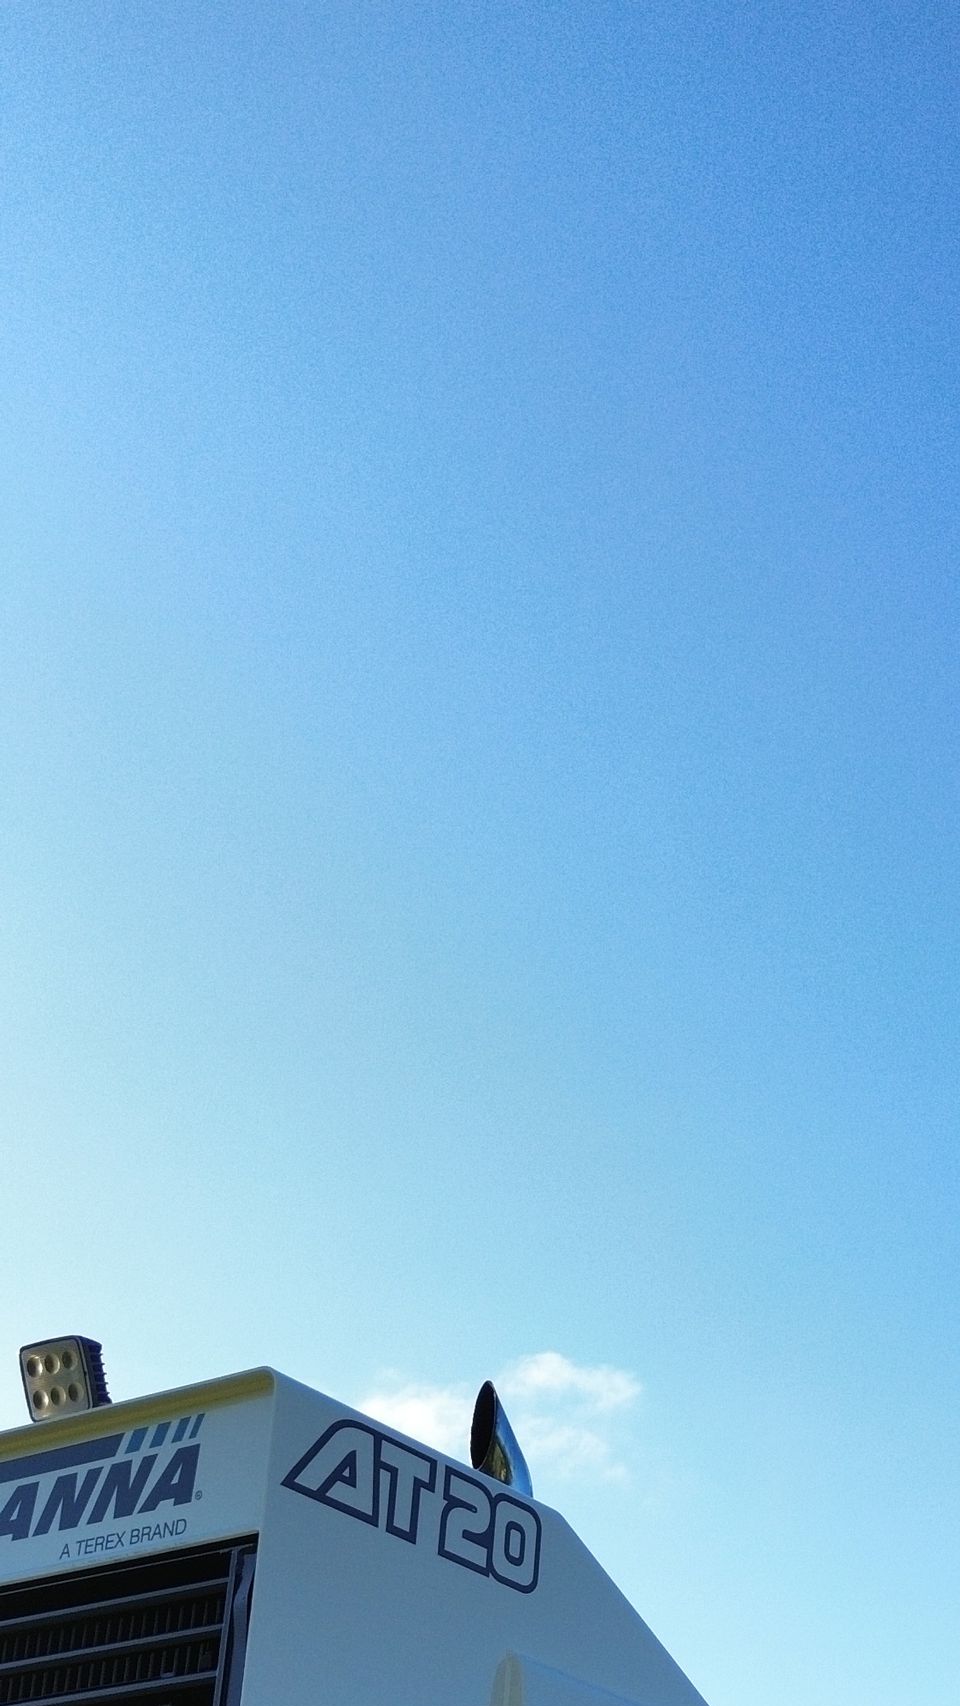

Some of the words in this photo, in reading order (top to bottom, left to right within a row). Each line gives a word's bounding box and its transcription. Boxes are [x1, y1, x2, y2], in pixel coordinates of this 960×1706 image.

[59, 1544, 71, 1560] A
[76, 1531, 127, 1556] TEREX
[129, 1518, 187, 1545] BRAND
